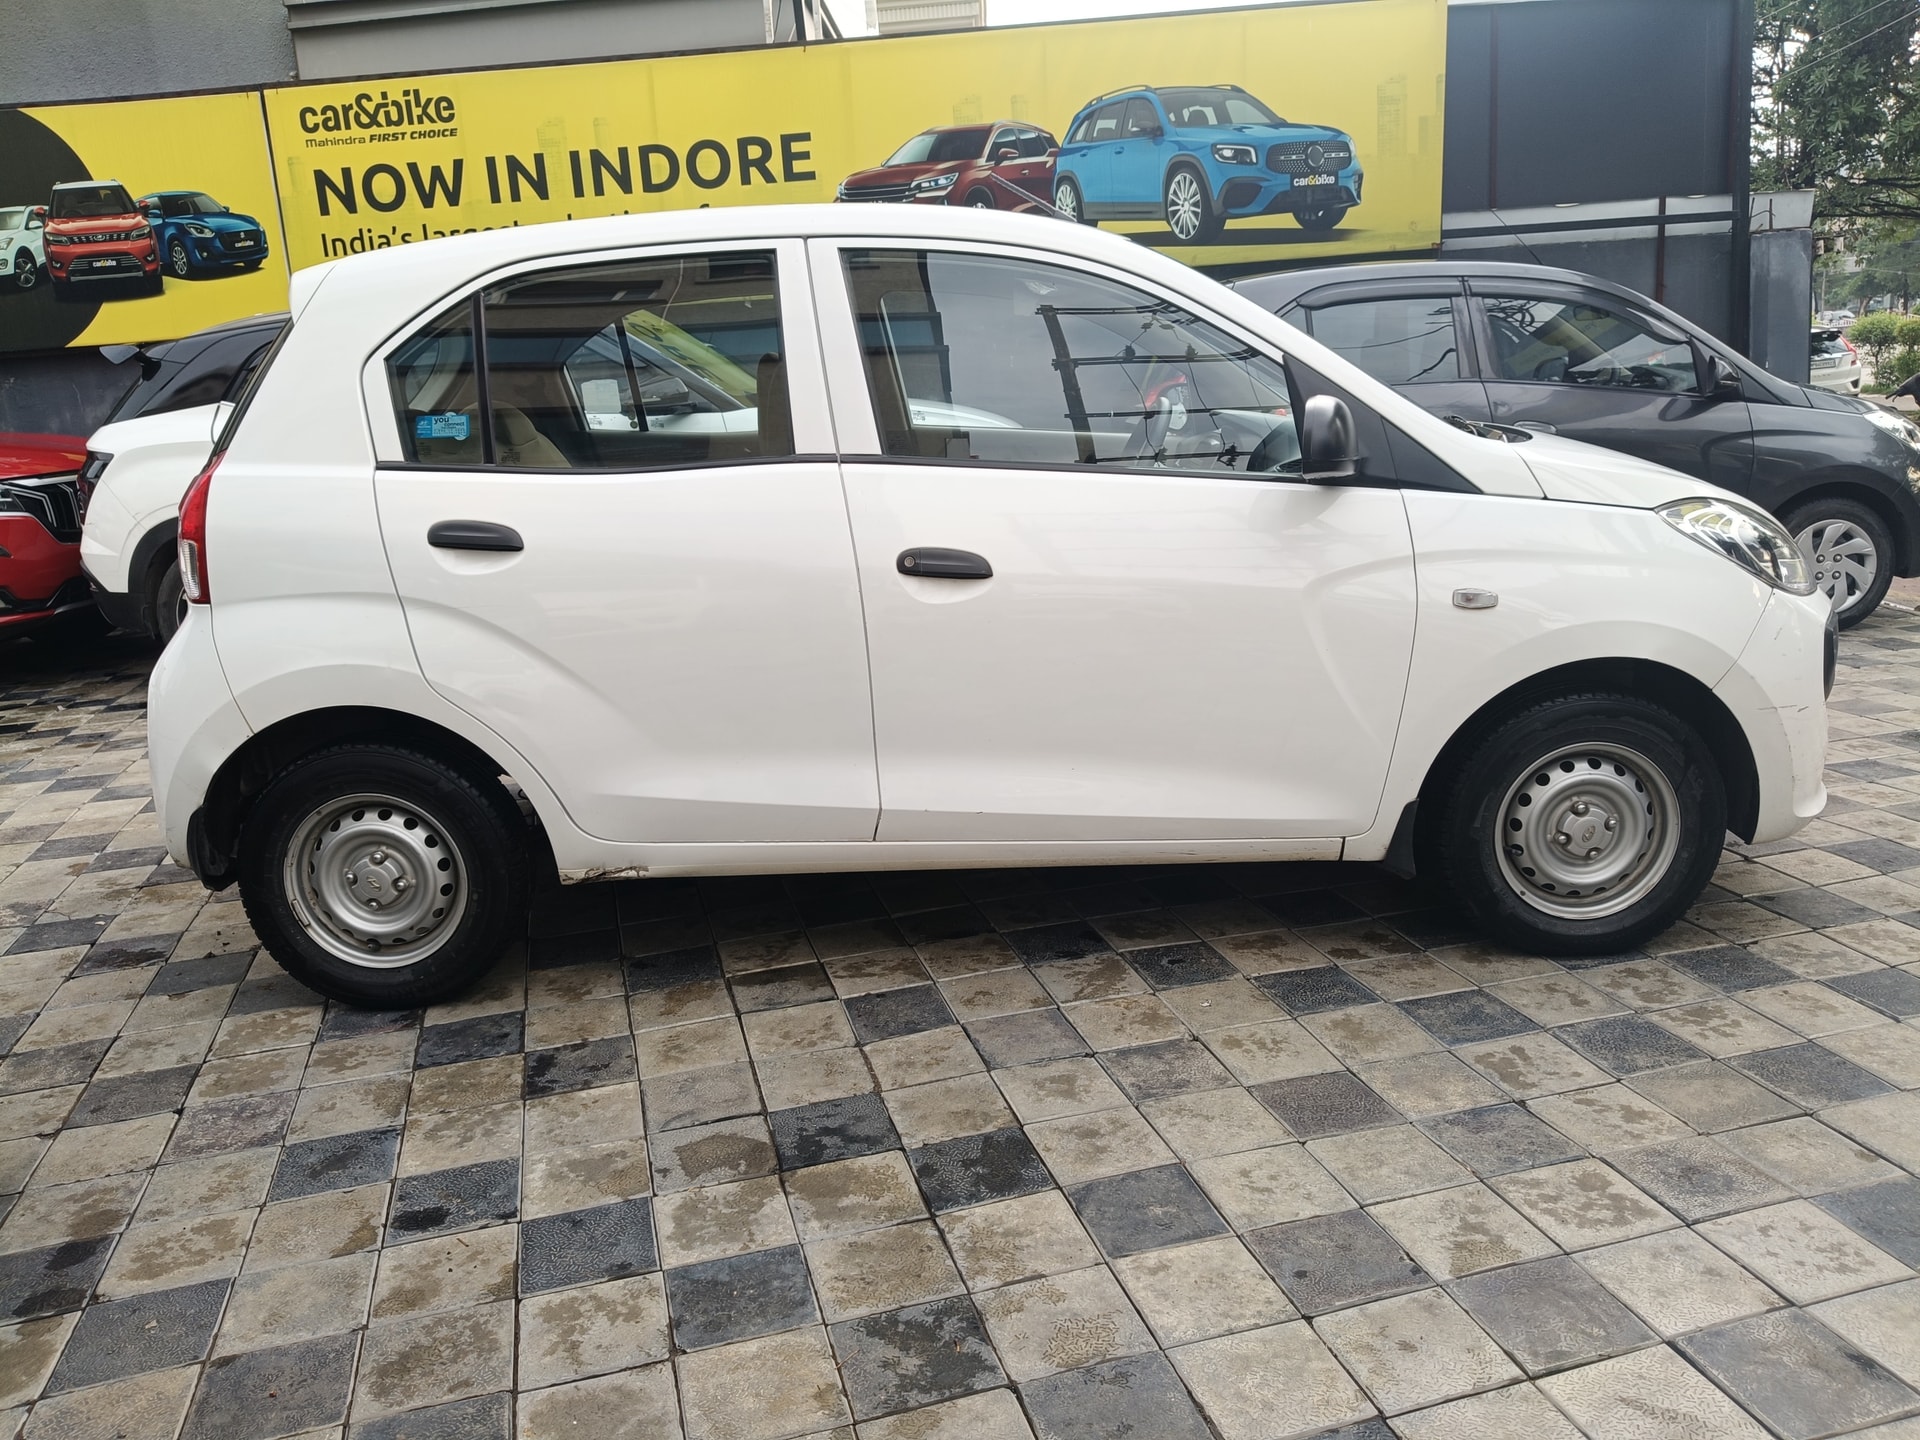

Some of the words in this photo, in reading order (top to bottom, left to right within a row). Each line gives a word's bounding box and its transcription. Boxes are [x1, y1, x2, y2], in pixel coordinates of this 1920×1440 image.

[300, 89, 455, 133] car&bike
[305, 136, 366, 148] Mahindra
[369, 132, 408, 143] FIRST
[410, 128, 458, 140] CHOICE
[314, 157, 464, 216] NOW
[485, 153, 551, 204] IN
[569, 131, 817, 199] INDORE
[1294, 174, 1335, 186] car&bike
[321, 226, 412, 257] India's
[434, 417, 449, 425] you
